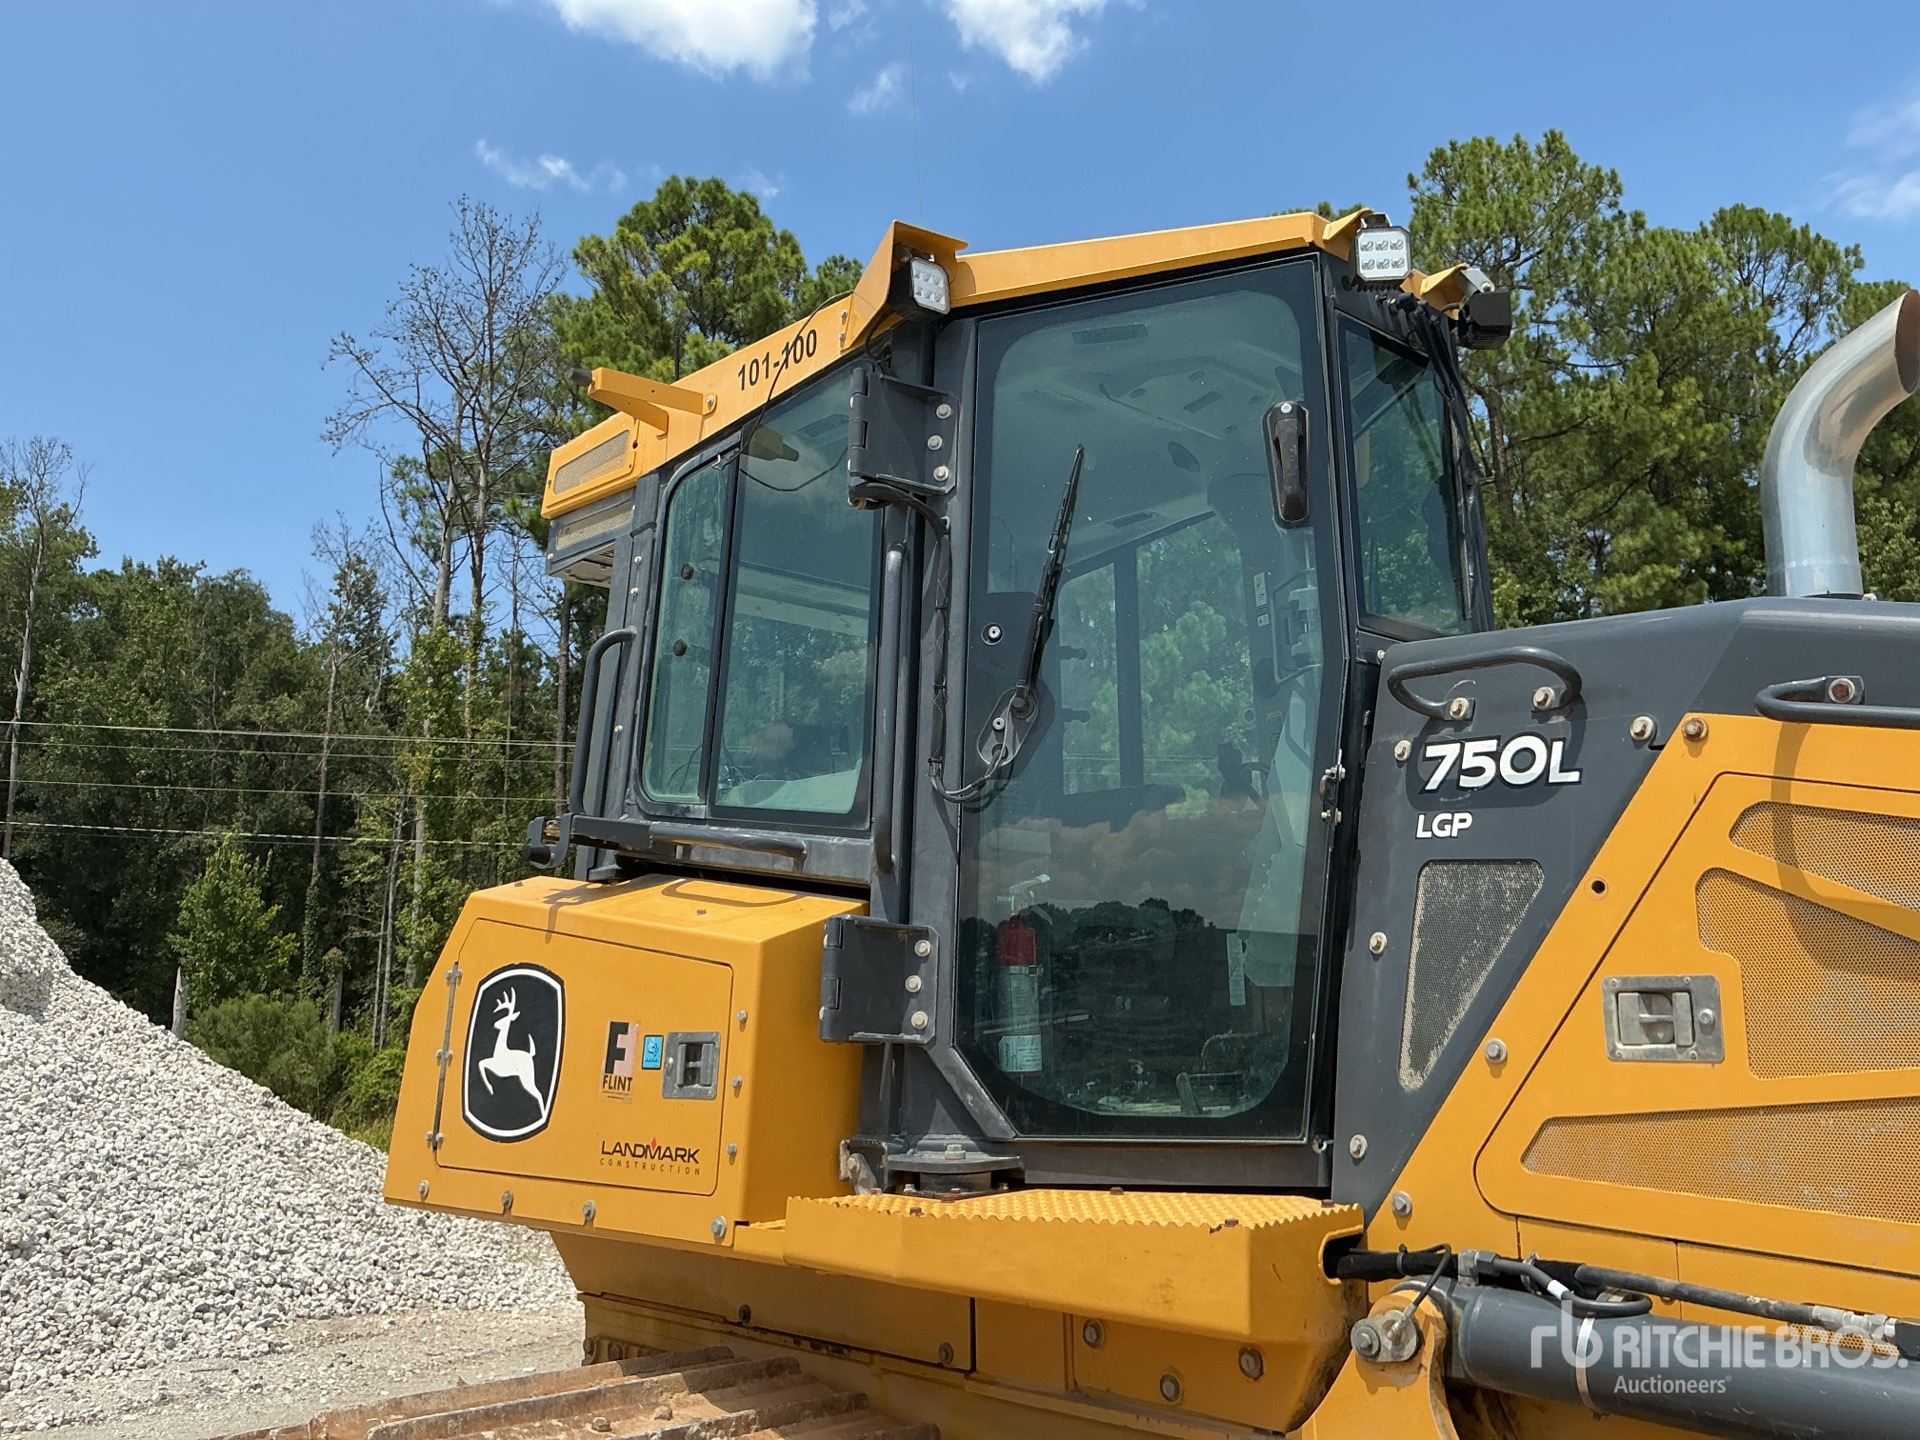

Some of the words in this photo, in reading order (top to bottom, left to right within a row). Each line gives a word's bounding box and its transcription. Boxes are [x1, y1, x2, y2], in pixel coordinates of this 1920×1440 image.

[738, 329, 817, 390] 101-100
[1423, 734, 1581, 791] 750L
[1416, 812, 1472, 838] LGP
[602, 1074, 633, 1092] FLINT
[601, 1140, 700, 1164] LANDMARK
[600, 1157, 700, 1175] CONSTRUCTION
